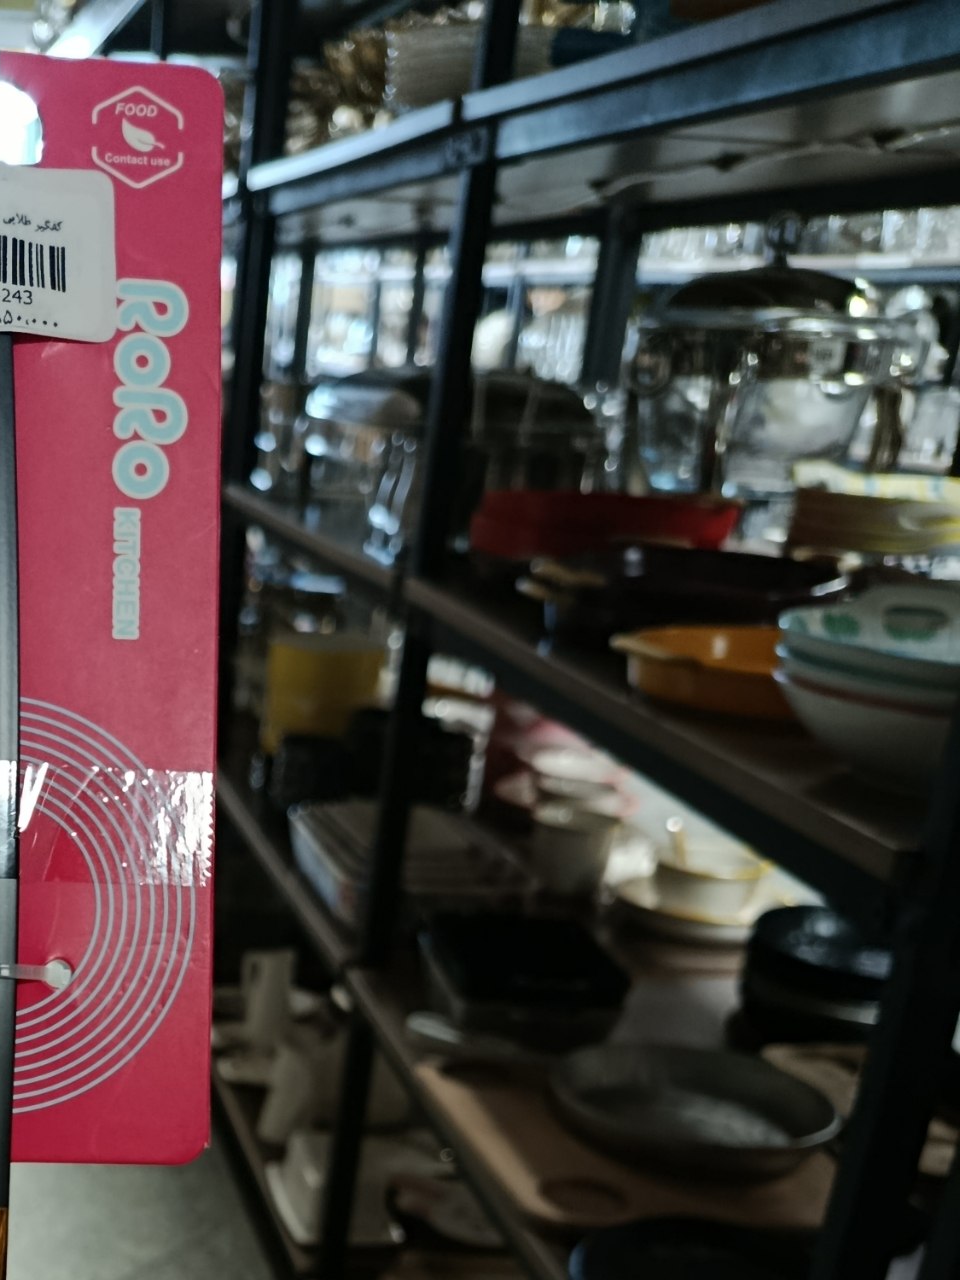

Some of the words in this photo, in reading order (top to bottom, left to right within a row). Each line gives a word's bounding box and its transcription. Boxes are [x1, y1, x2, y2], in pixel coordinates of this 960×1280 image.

[115, 103, 158, 117] FOOD
[104, 152, 148, 165] Contact
[150, 157, 171, 166] use
[112, 507, 141, 640] KITCHEN
